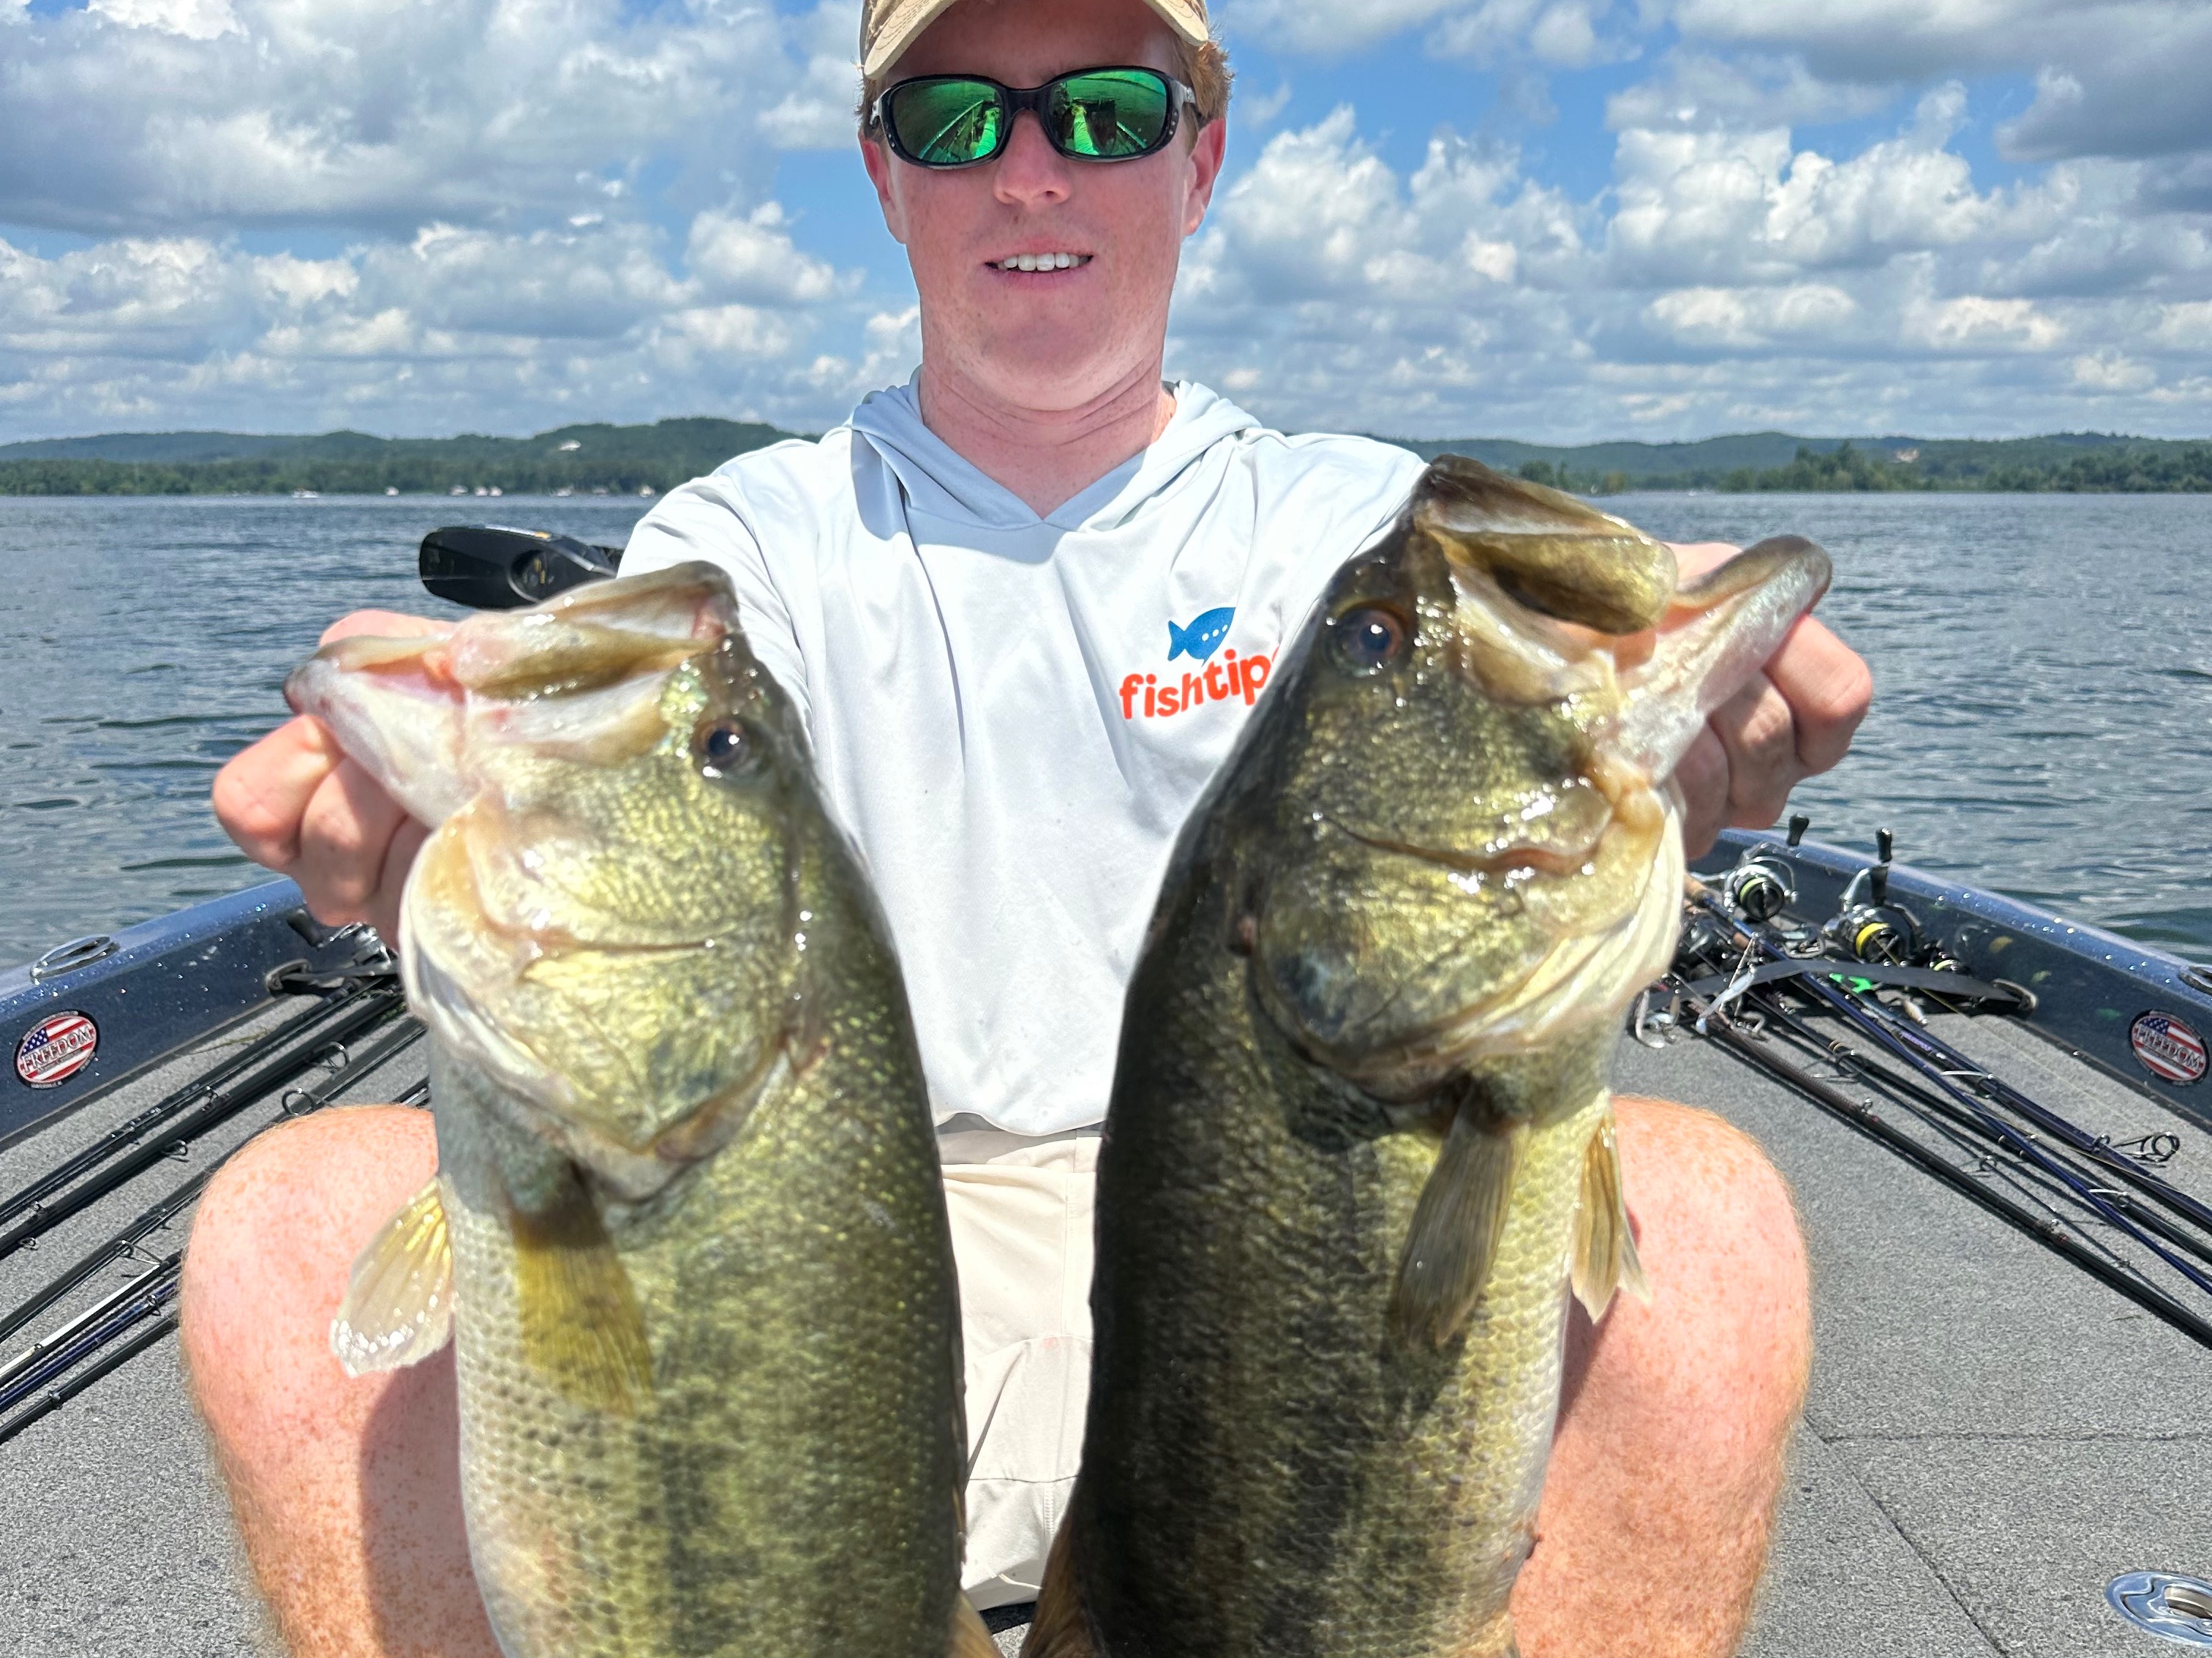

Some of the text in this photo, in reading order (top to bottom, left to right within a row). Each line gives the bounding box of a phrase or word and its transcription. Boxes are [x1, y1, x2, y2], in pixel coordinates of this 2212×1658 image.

[1119, 645, 1280, 720] fishtip
[20, 1025, 94, 1072] FREEDOM
[2136, 1024, 2201, 1070] FREEDOM
